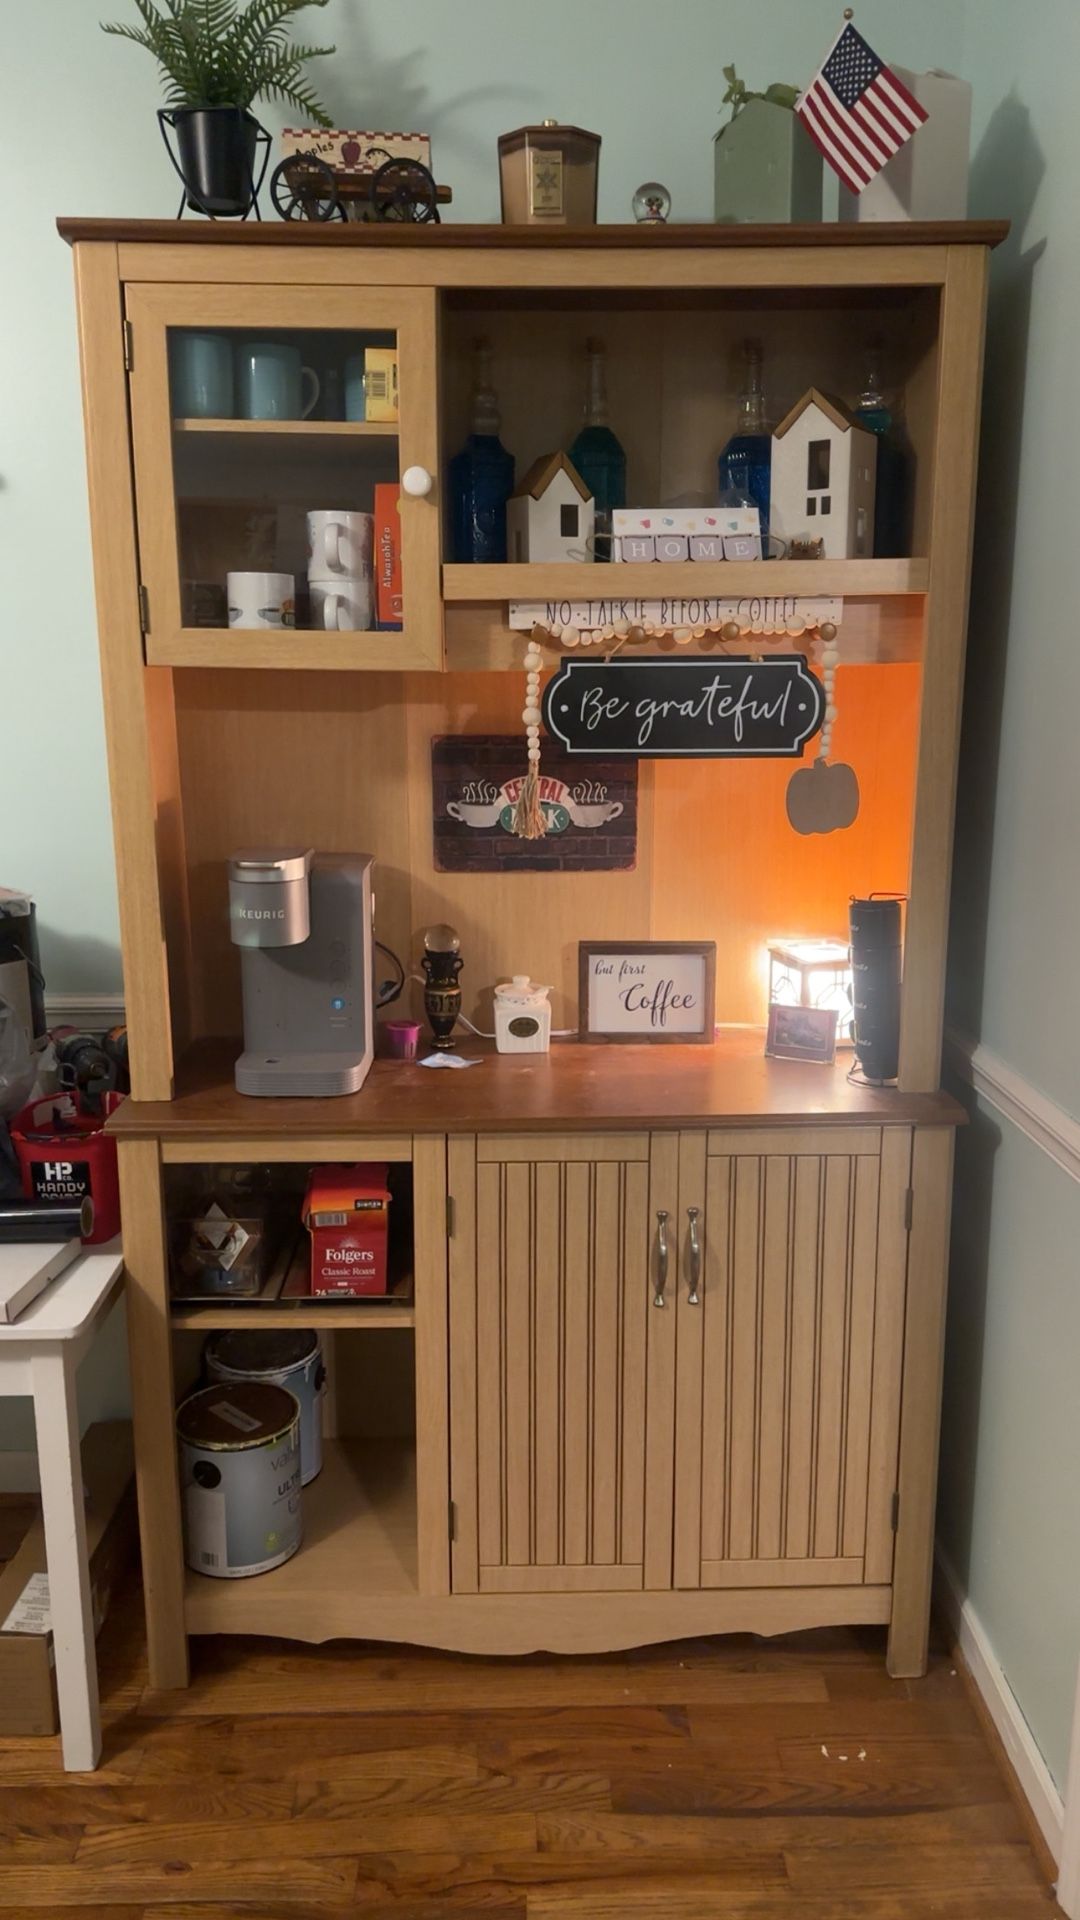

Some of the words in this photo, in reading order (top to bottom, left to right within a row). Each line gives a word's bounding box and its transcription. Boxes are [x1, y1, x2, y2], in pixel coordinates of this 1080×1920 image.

[631, 540, 751, 558] HOME
[546, 600, 572, 623] NO
[587, 599, 647, 625] TALKIE
[661, 599, 722, 624] BEFORE
[737, 597, 799, 621] COFFEE
[580, 687, 629, 730] Be
[635, 675, 793, 746] grateful
[504, 778, 564, 804] CERAL
[239, 908, 285, 920] KEURIG
[594, 959, 615, 976] but
[618, 959, 647, 983] first
[619, 979, 696, 1027] Coffee
[36, 1182, 86, 1192] HANDY
[325, 1248, 374, 1264] Folgers
[321, 1267, 350, 1276] Classic
[352, 1267, 376, 1276] Roast
